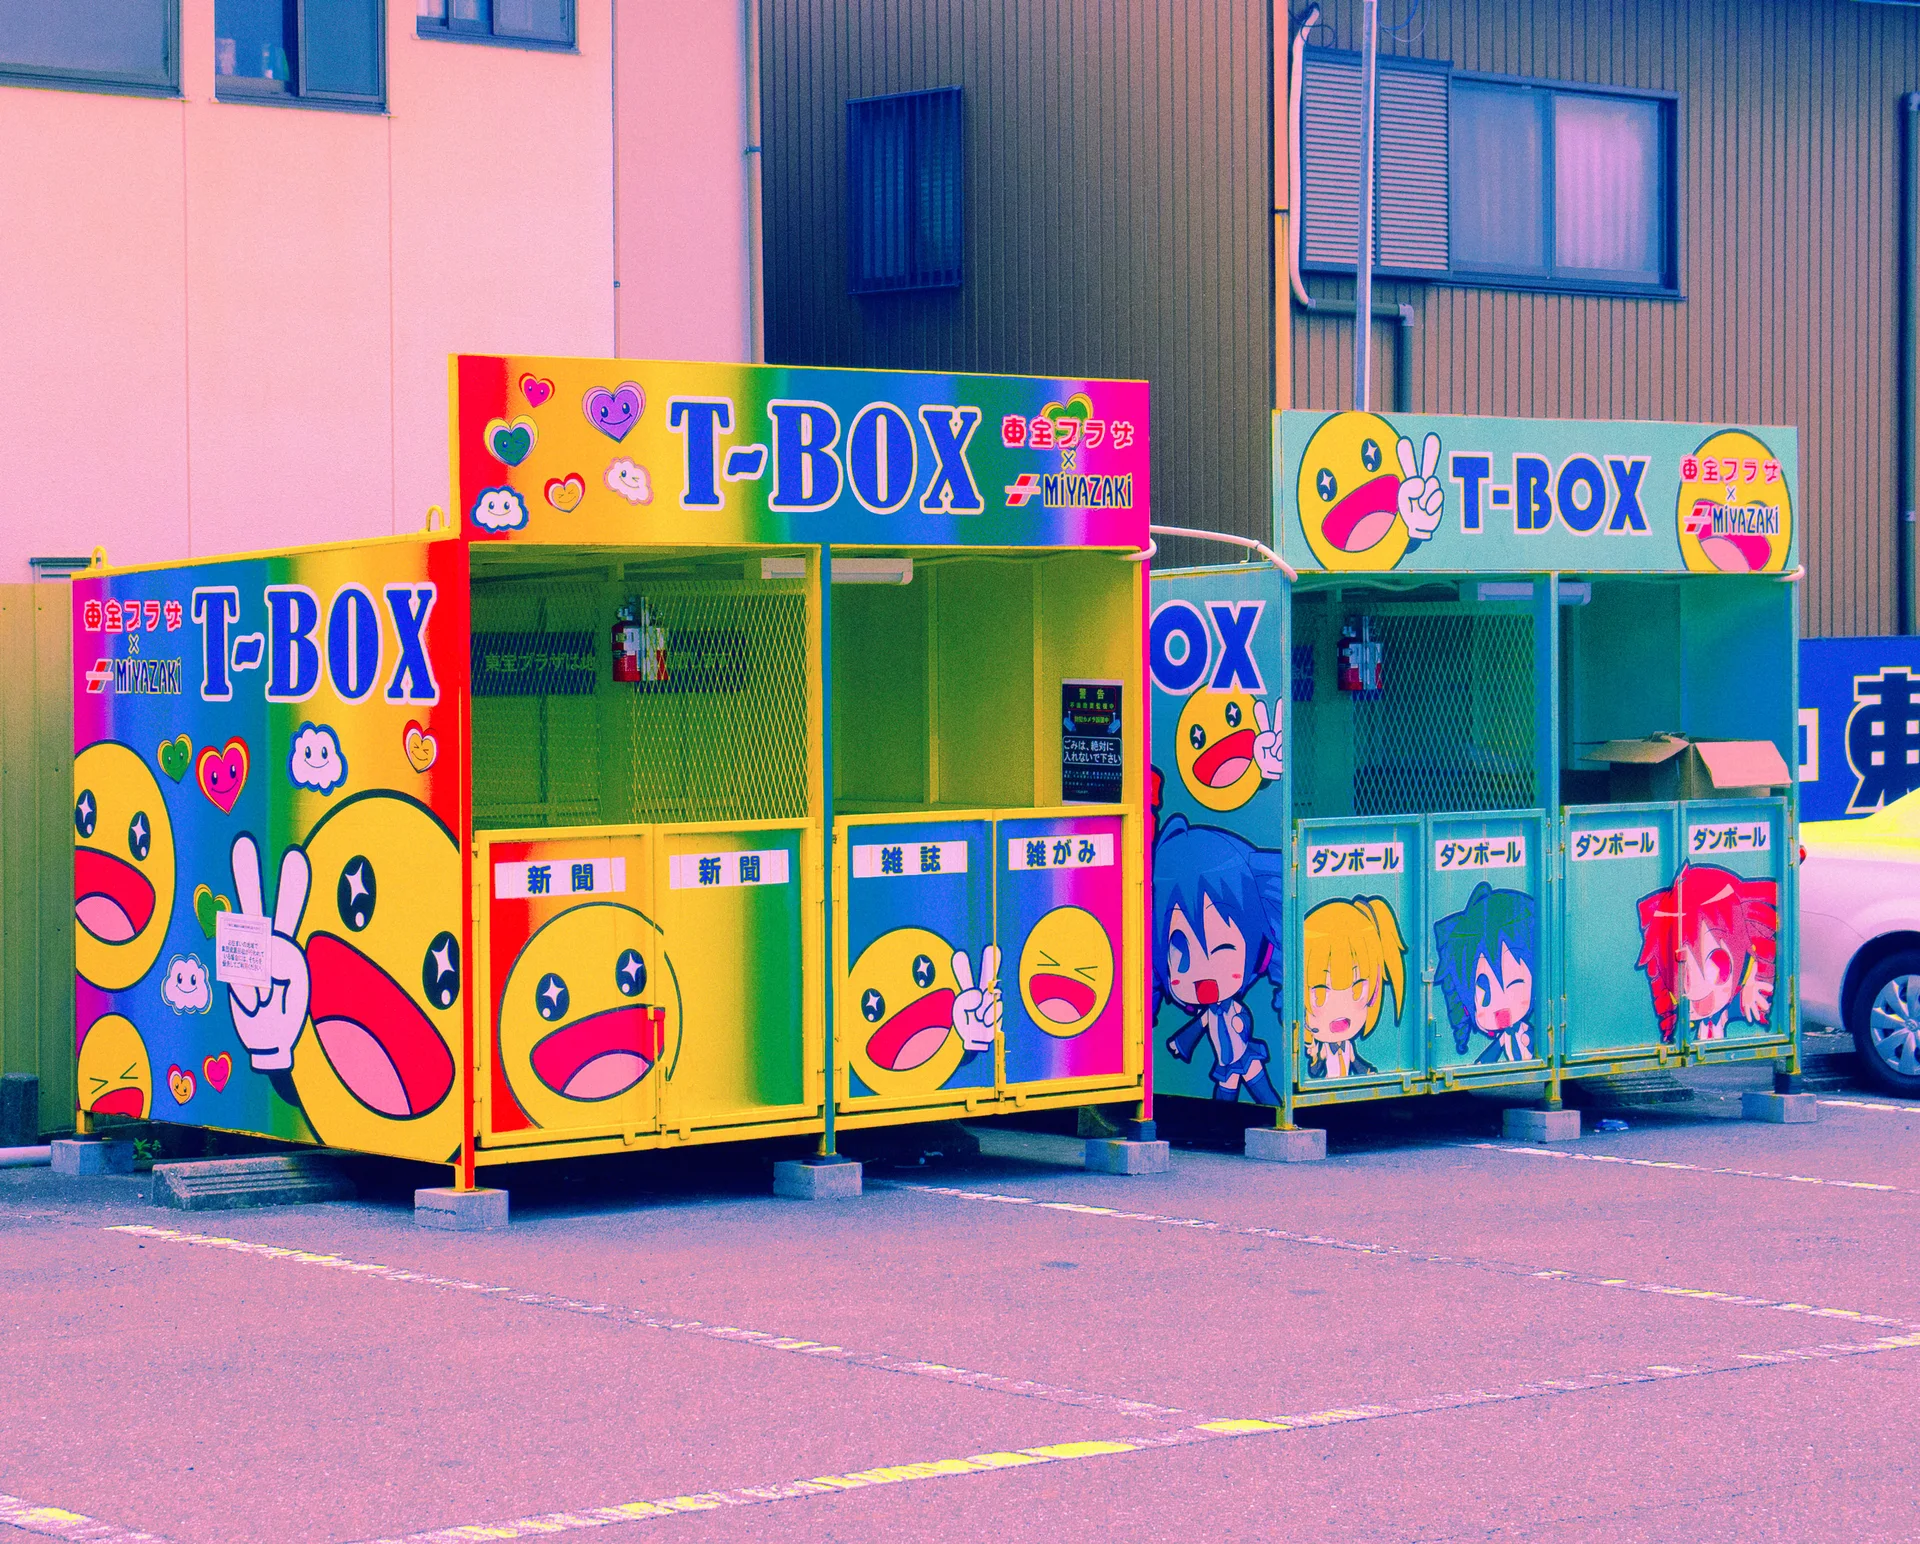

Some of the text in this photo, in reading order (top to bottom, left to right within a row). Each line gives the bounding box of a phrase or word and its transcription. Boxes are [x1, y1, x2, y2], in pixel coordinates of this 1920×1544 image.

[667, 395, 985, 515] T-BOX
[1449, 451, 1652, 537] T-BOX
[191, 582, 440, 706] T-BOX
[1064, 740, 1114, 752] ごみは、絶対に
[1064, 752, 1121, 764] 入れないで下さい
[1026, 839, 1096, 867] 雑がみ
[1576, 832, 1655, 858] ダンボール
[1693, 826, 1766, 852] ダンボール
[881, 845, 941, 874] 雑誌
[1311, 846, 1399, 873] ダンボール
[1439, 840, 1521, 867] ダンボール
[528, 863, 594, 894] 新聞
[699, 855, 761, 885] 新聞
